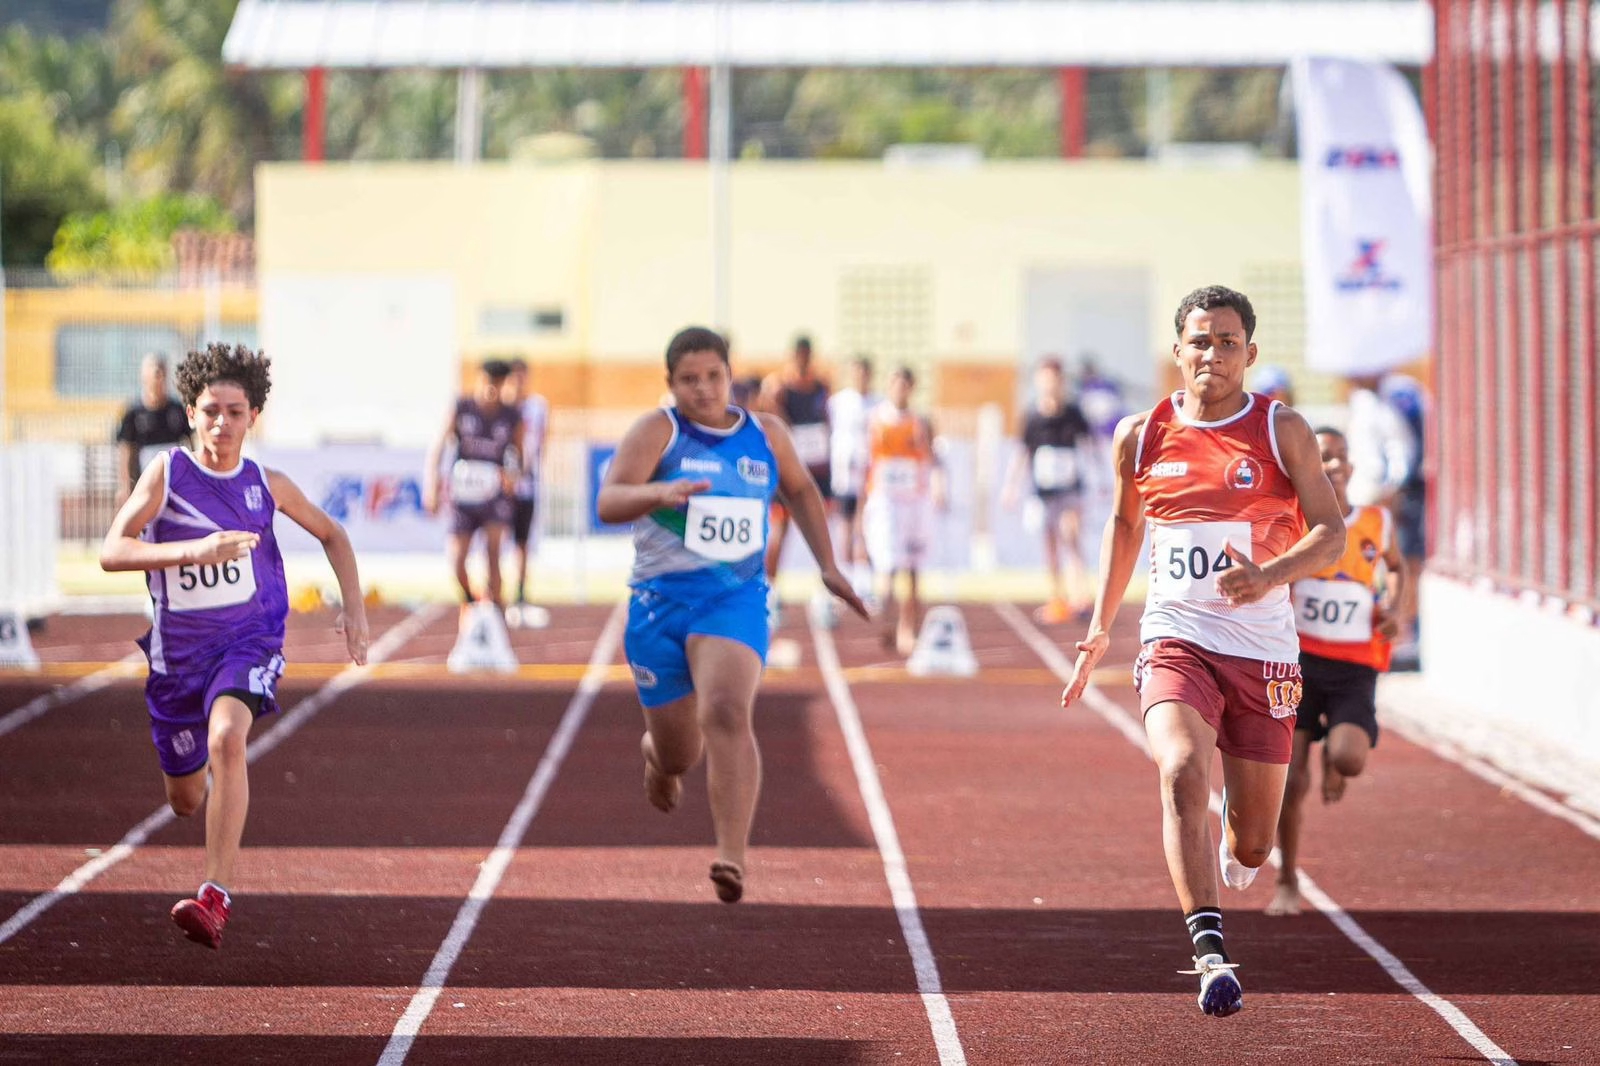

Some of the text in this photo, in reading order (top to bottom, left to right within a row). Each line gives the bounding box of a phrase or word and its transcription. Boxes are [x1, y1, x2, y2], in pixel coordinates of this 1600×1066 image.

[700, 516, 751, 543] 508
[180, 558, 240, 591] 506
[1169, 546, 1234, 580] 504
[1303, 597, 1358, 624] 507
